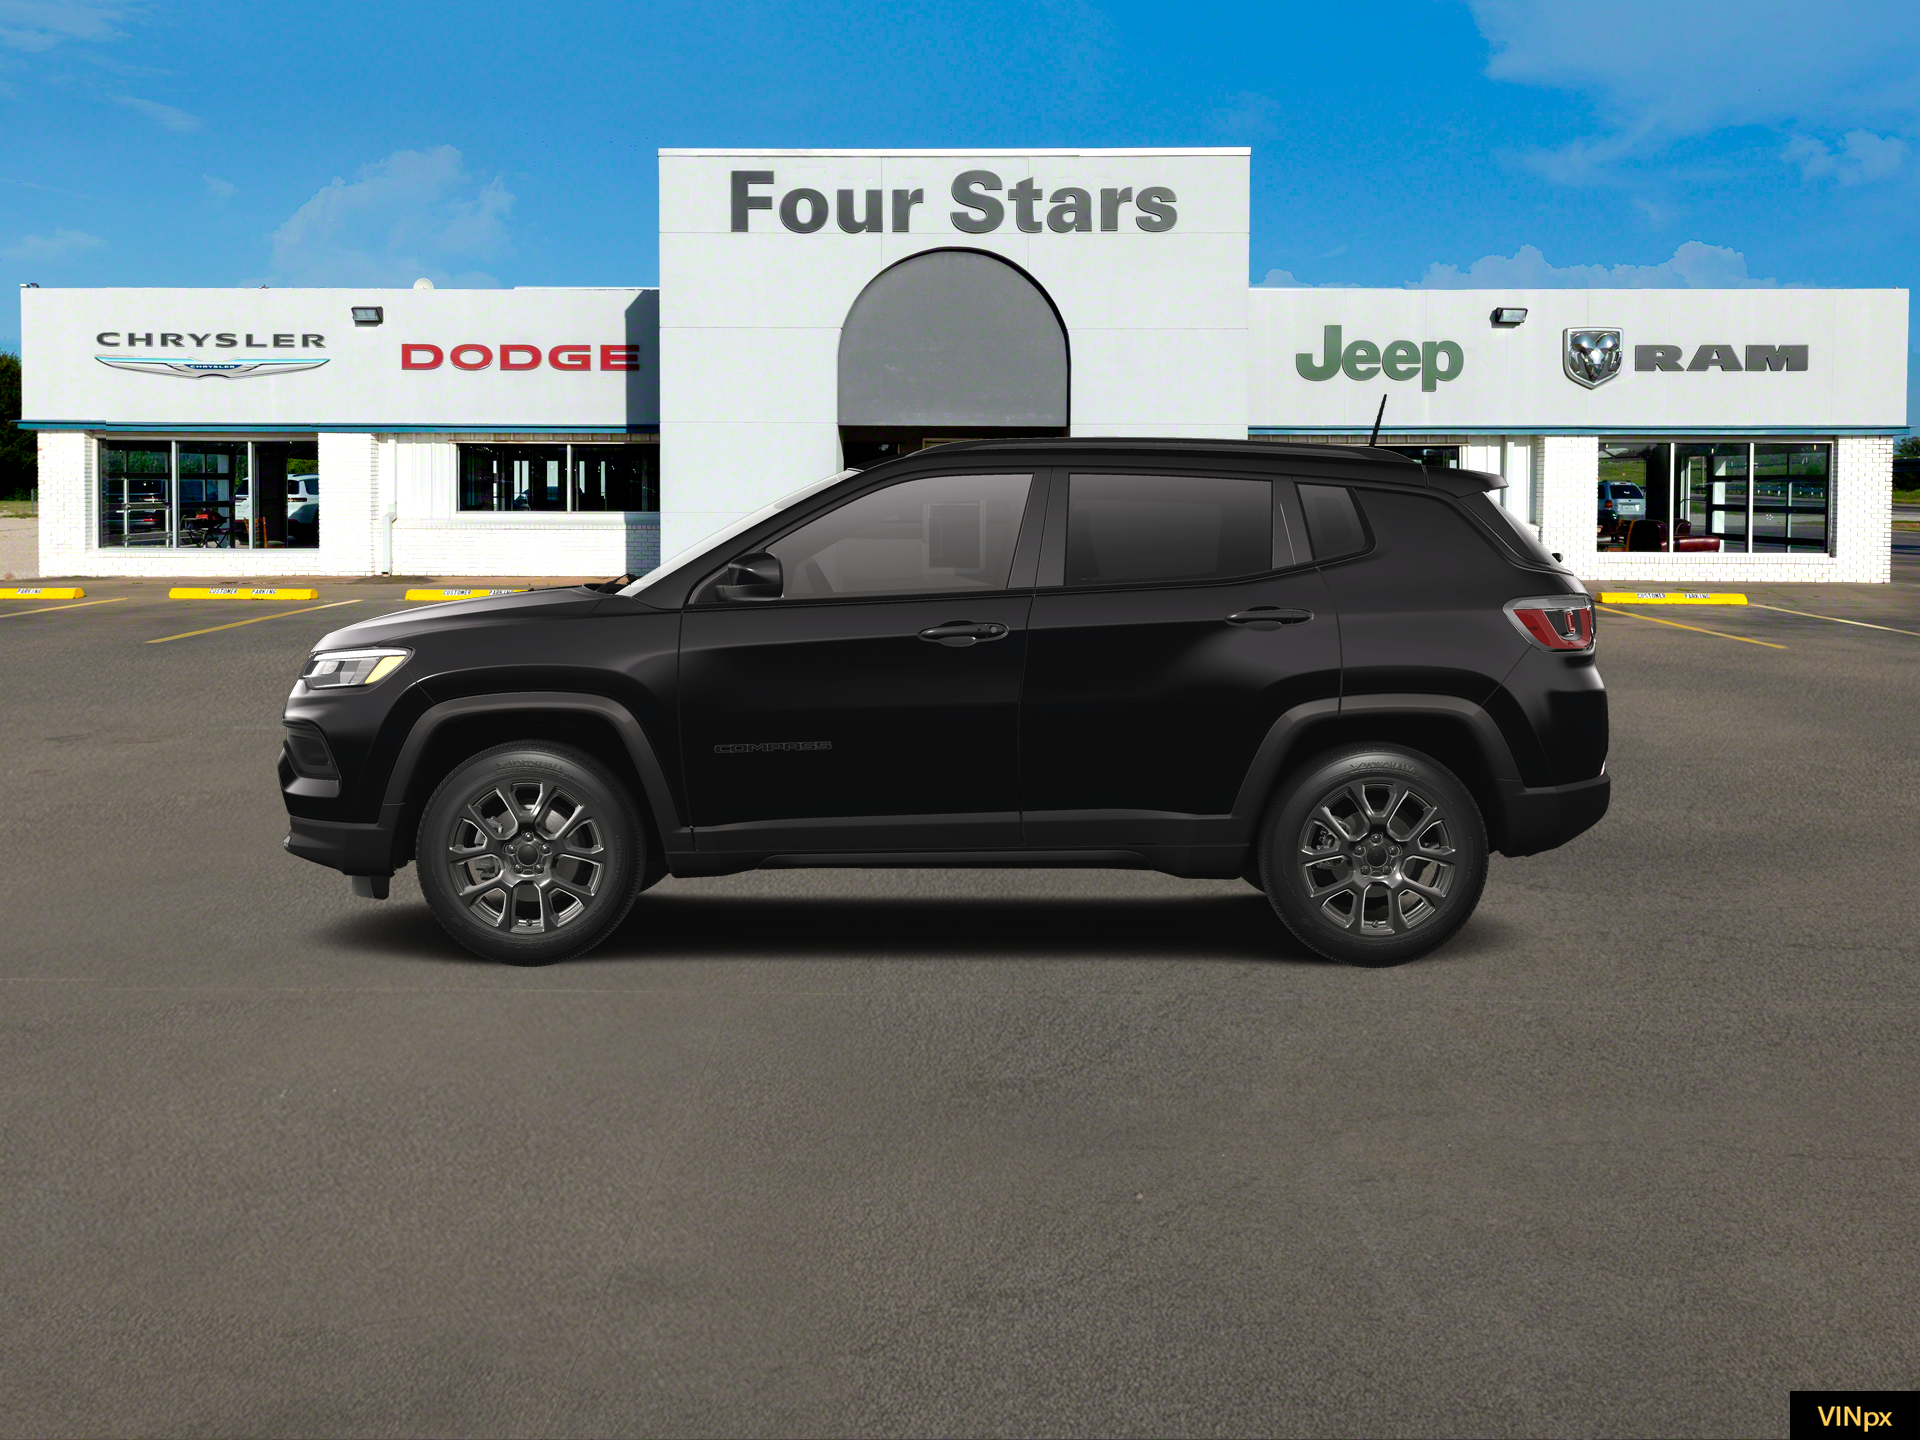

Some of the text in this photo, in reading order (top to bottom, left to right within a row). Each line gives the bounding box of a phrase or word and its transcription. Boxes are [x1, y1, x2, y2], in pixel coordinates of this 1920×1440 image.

[731, 170, 1177, 233] Four Stars
[96, 332, 326, 348] CHRYSLER
[401, 343, 640, 371] DODGE
[1295, 325, 1464, 392] Jeep
[1635, 344, 1809, 371] RAM
[714, 741, 832, 753] COMPASS
